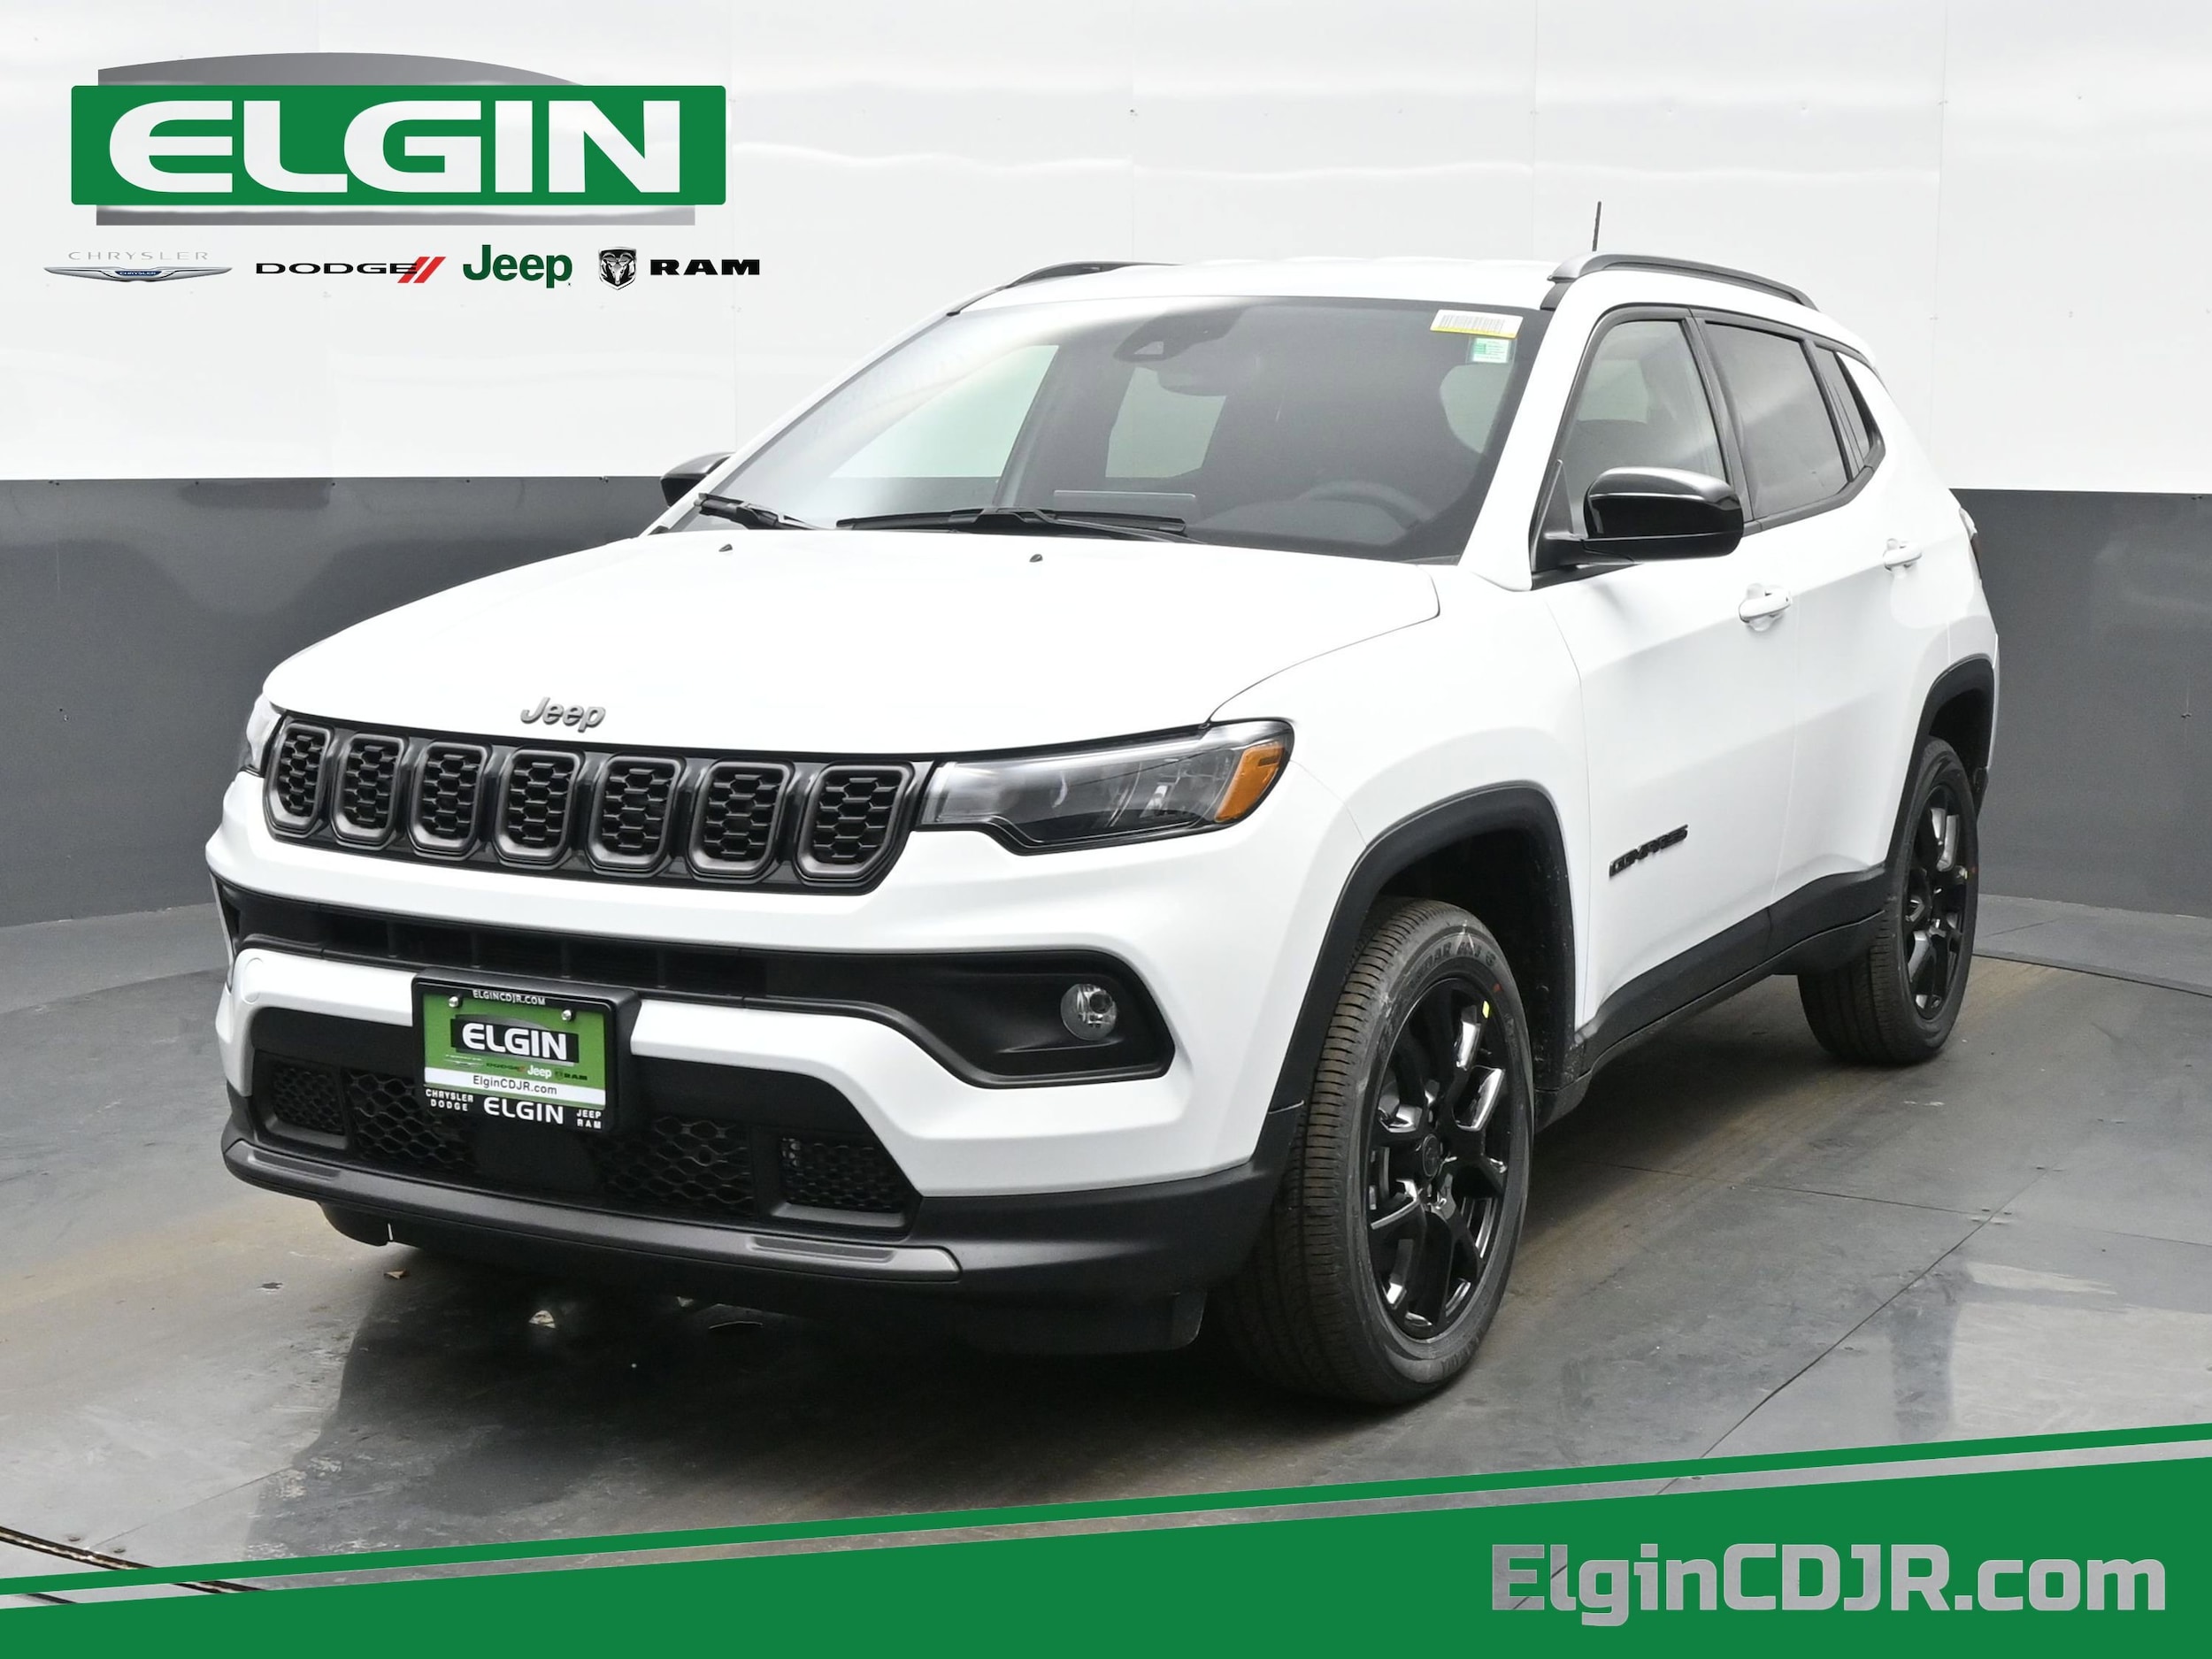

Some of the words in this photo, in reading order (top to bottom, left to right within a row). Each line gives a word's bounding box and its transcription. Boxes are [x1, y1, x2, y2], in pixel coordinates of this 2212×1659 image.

[520, 696, 606, 733] Jeep
[472, 989, 546, 1005] ELGINCDJR.COM
[462, 1022, 567, 1061] ELGIN
[527, 1064, 552, 1079] Jeep
[472, 1075, 557, 1095] ElginCDJR.com
[426, 1088, 473, 1102] CHRYSLER
[430, 1099, 469, 1112] DODGE
[483, 1096, 564, 1124] ELGIN
[576, 1109, 602, 1119] JEEP
[576, 1118, 602, 1129] RAM
